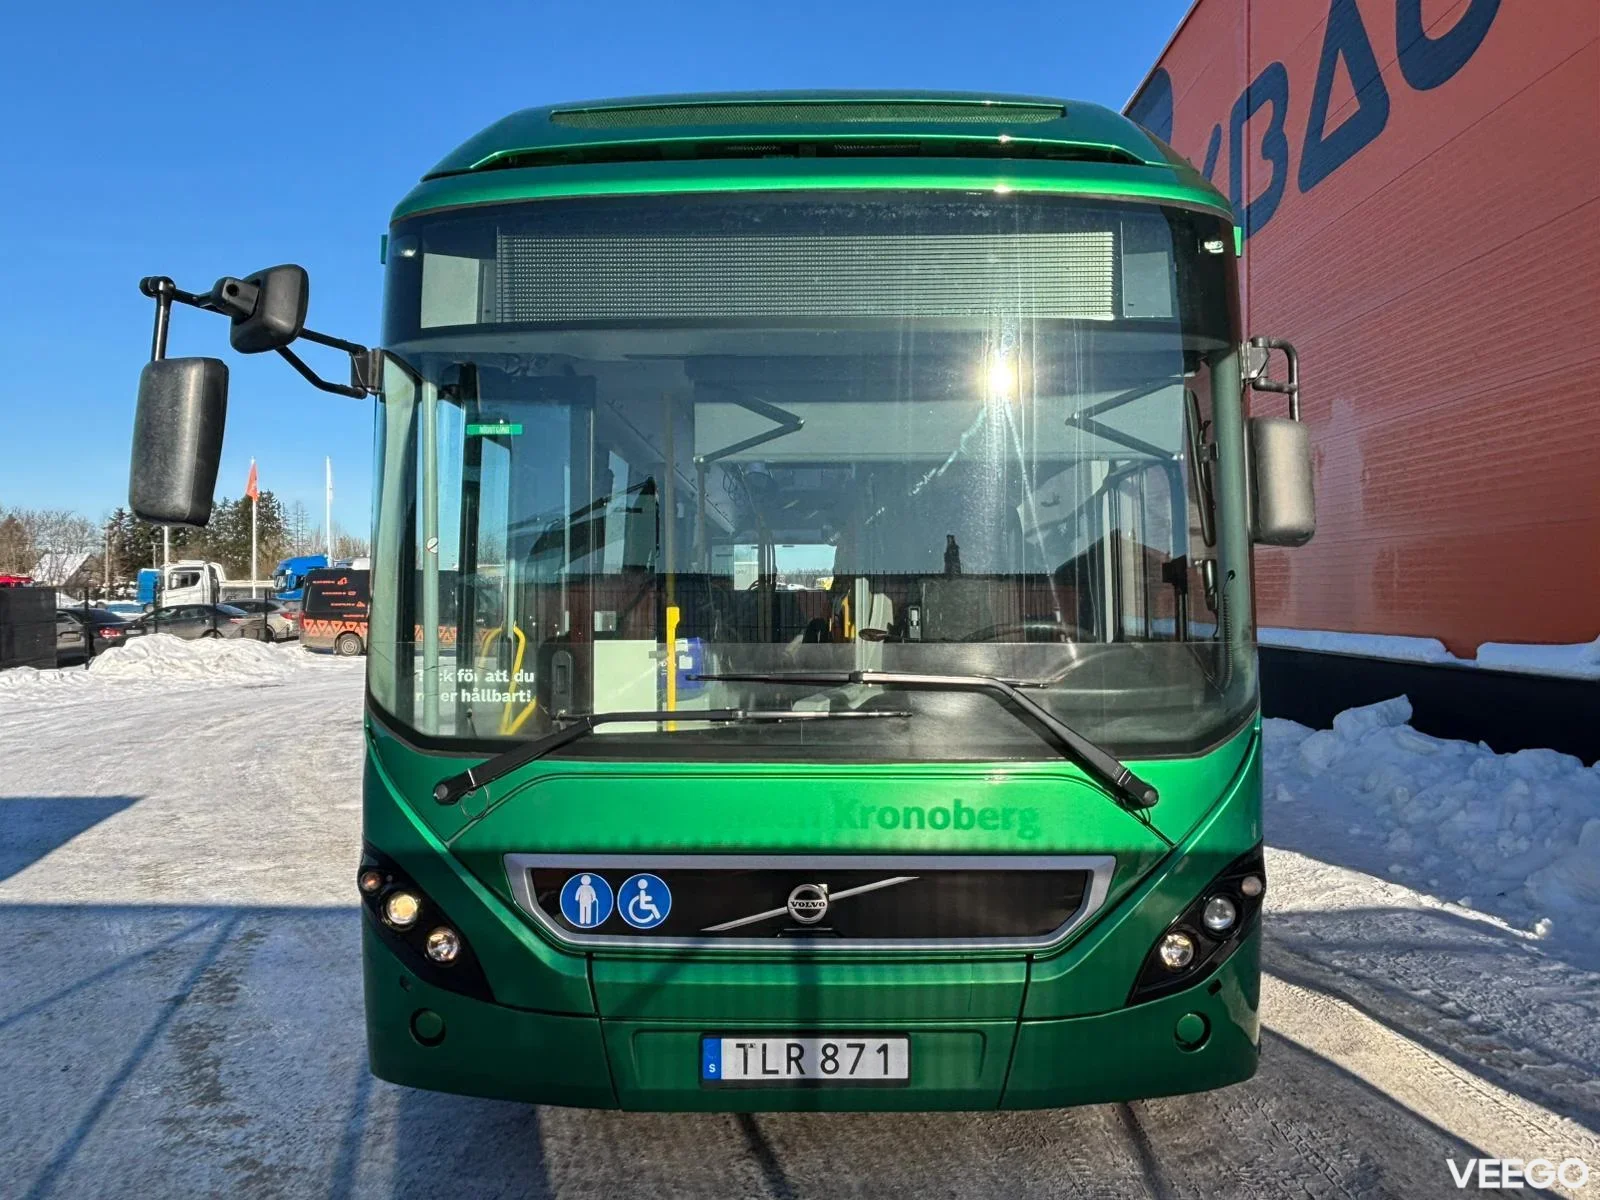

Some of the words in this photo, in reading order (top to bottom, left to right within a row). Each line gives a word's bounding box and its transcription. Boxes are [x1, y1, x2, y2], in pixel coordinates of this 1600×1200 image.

[485, 670, 510, 682] att
[513, 669, 535, 682] du
[461, 687, 531, 703] hållbart!
[834, 798, 1041, 840] Kronoberg
[708, 1063, 716, 1073] S
[735, 1043, 805, 1075] TLR
[820, 1043, 889, 1075] 871
